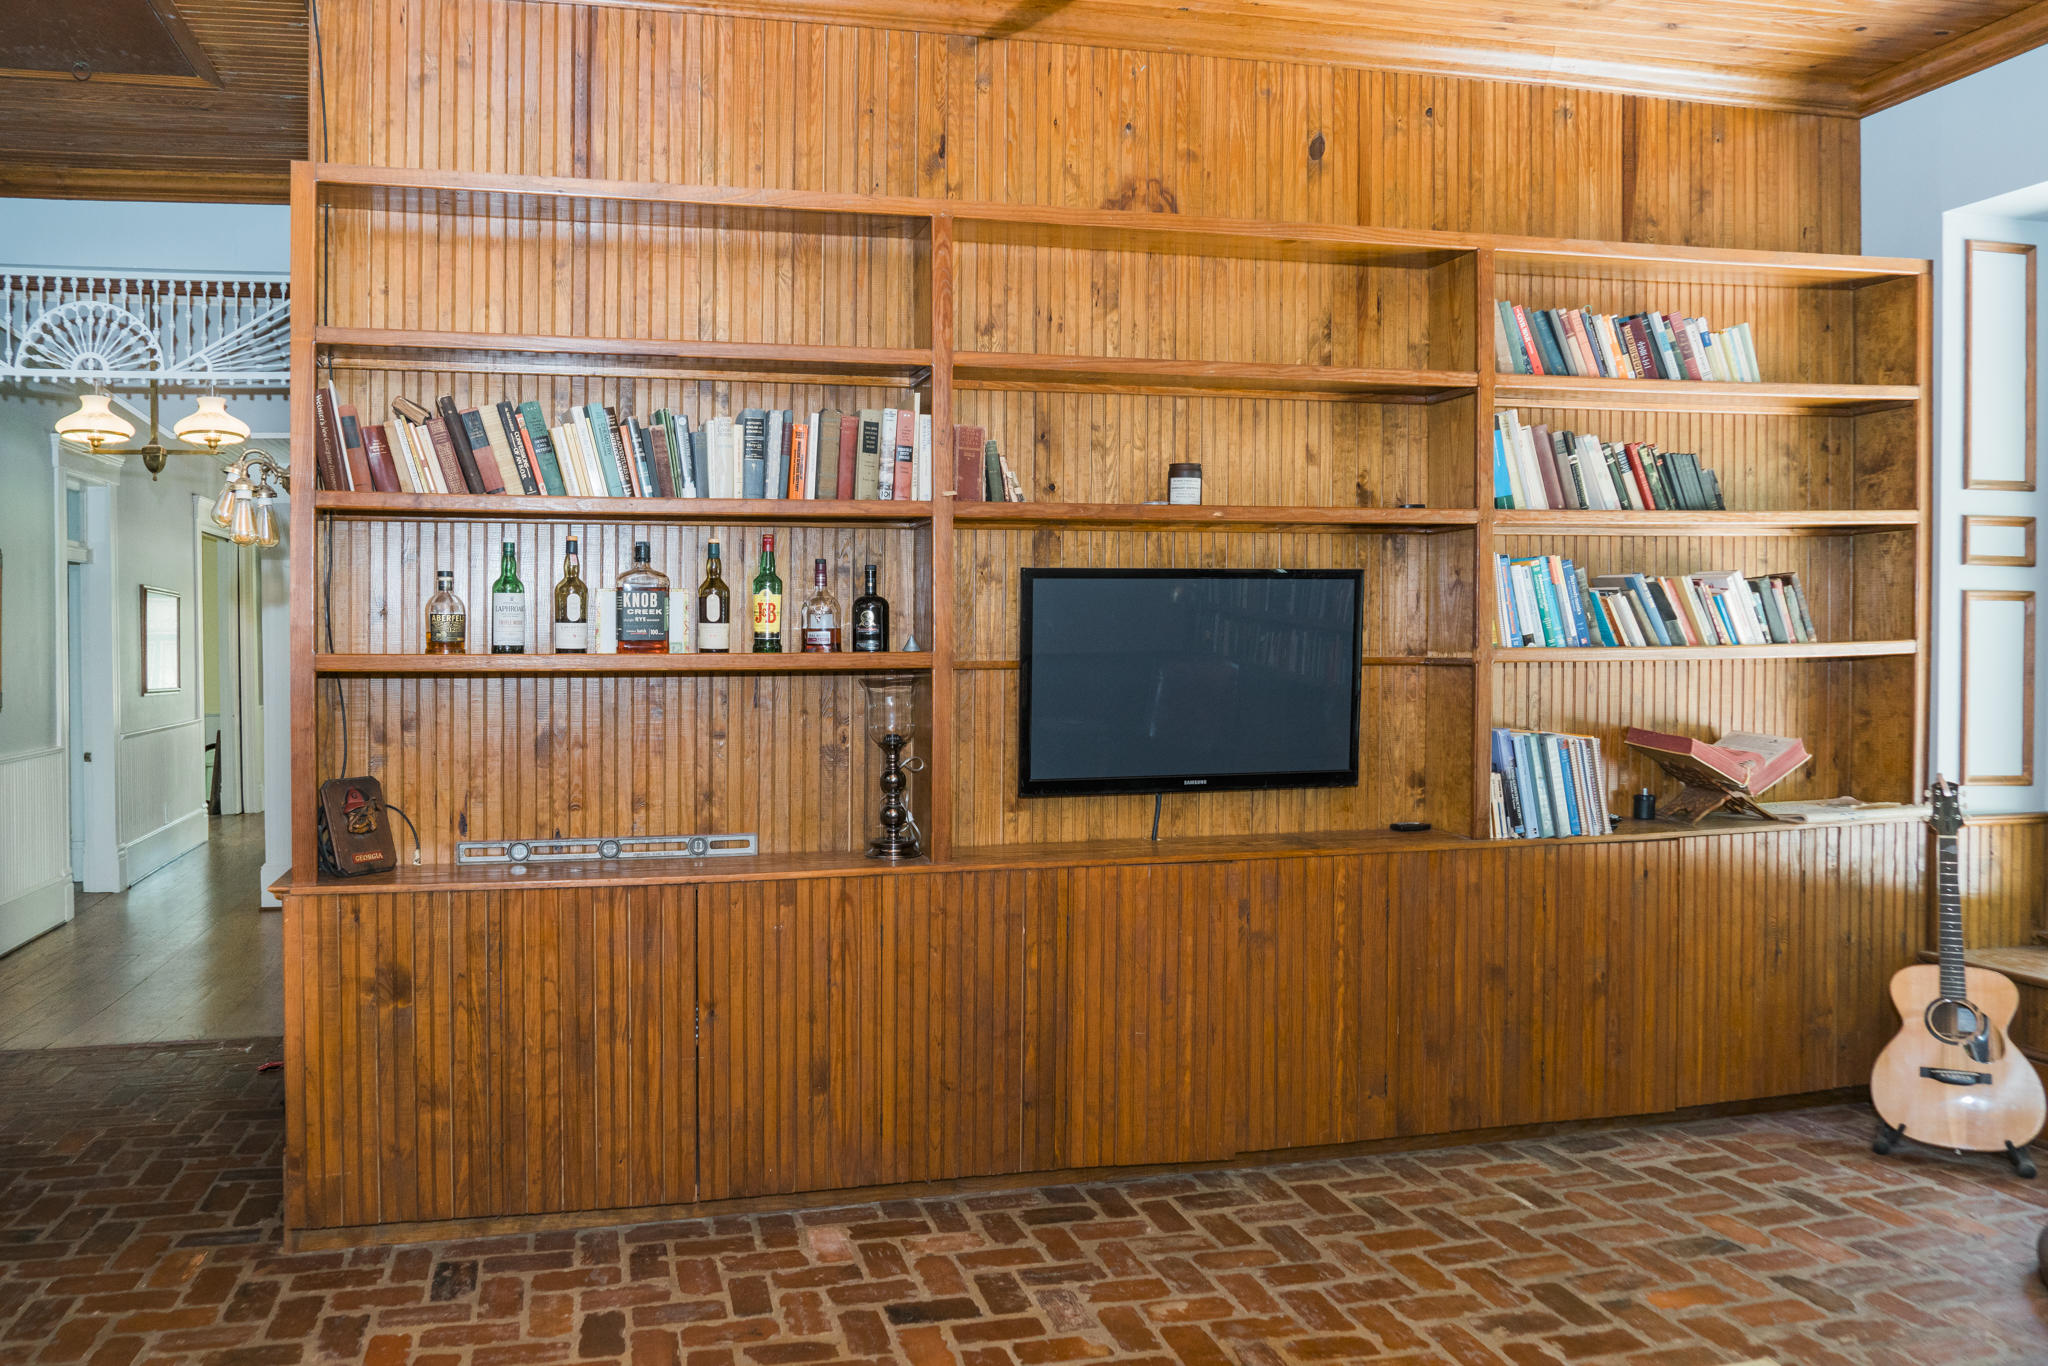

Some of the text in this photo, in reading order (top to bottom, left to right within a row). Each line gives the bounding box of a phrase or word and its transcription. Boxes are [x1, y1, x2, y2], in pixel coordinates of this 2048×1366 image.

[514, 431, 529, 468] CONFESSIONS
[514, 447, 519, 455] OF
[616, 440, 629, 475] ADVENTURES
[516, 456, 523, 465] AN
[623, 592, 658, 608] KNOB
[755, 602, 777, 624] J&B
[355, 852, 383, 862] GEORGIA
